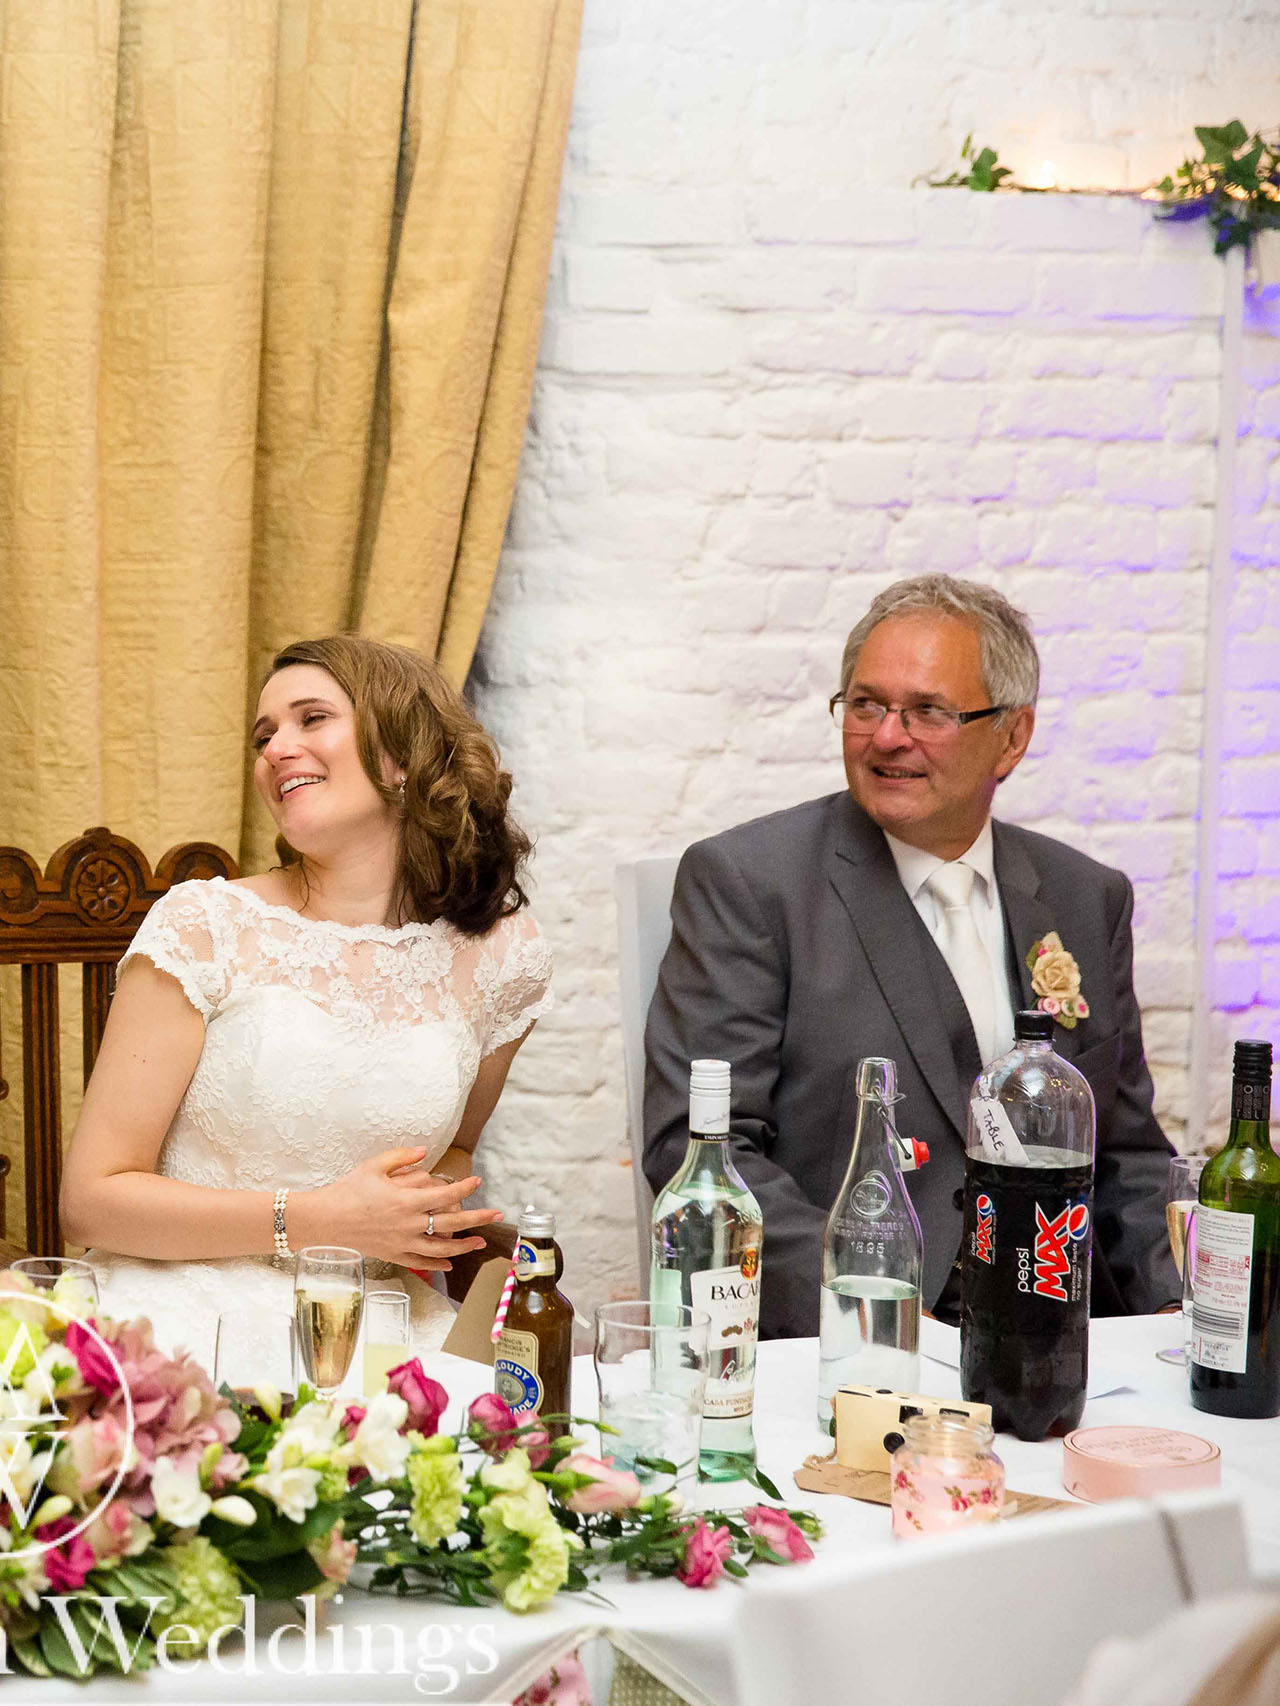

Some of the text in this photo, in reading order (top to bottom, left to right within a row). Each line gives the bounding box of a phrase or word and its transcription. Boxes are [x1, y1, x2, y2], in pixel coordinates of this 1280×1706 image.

[983, 1108, 1005, 1151] TABLE
[976, 1210, 993, 1265] MAX
[1033, 1200, 1071, 1302] MAX
[1016, 1247, 1031, 1293] pepsi
[1076, 1290, 1082, 1300] no
